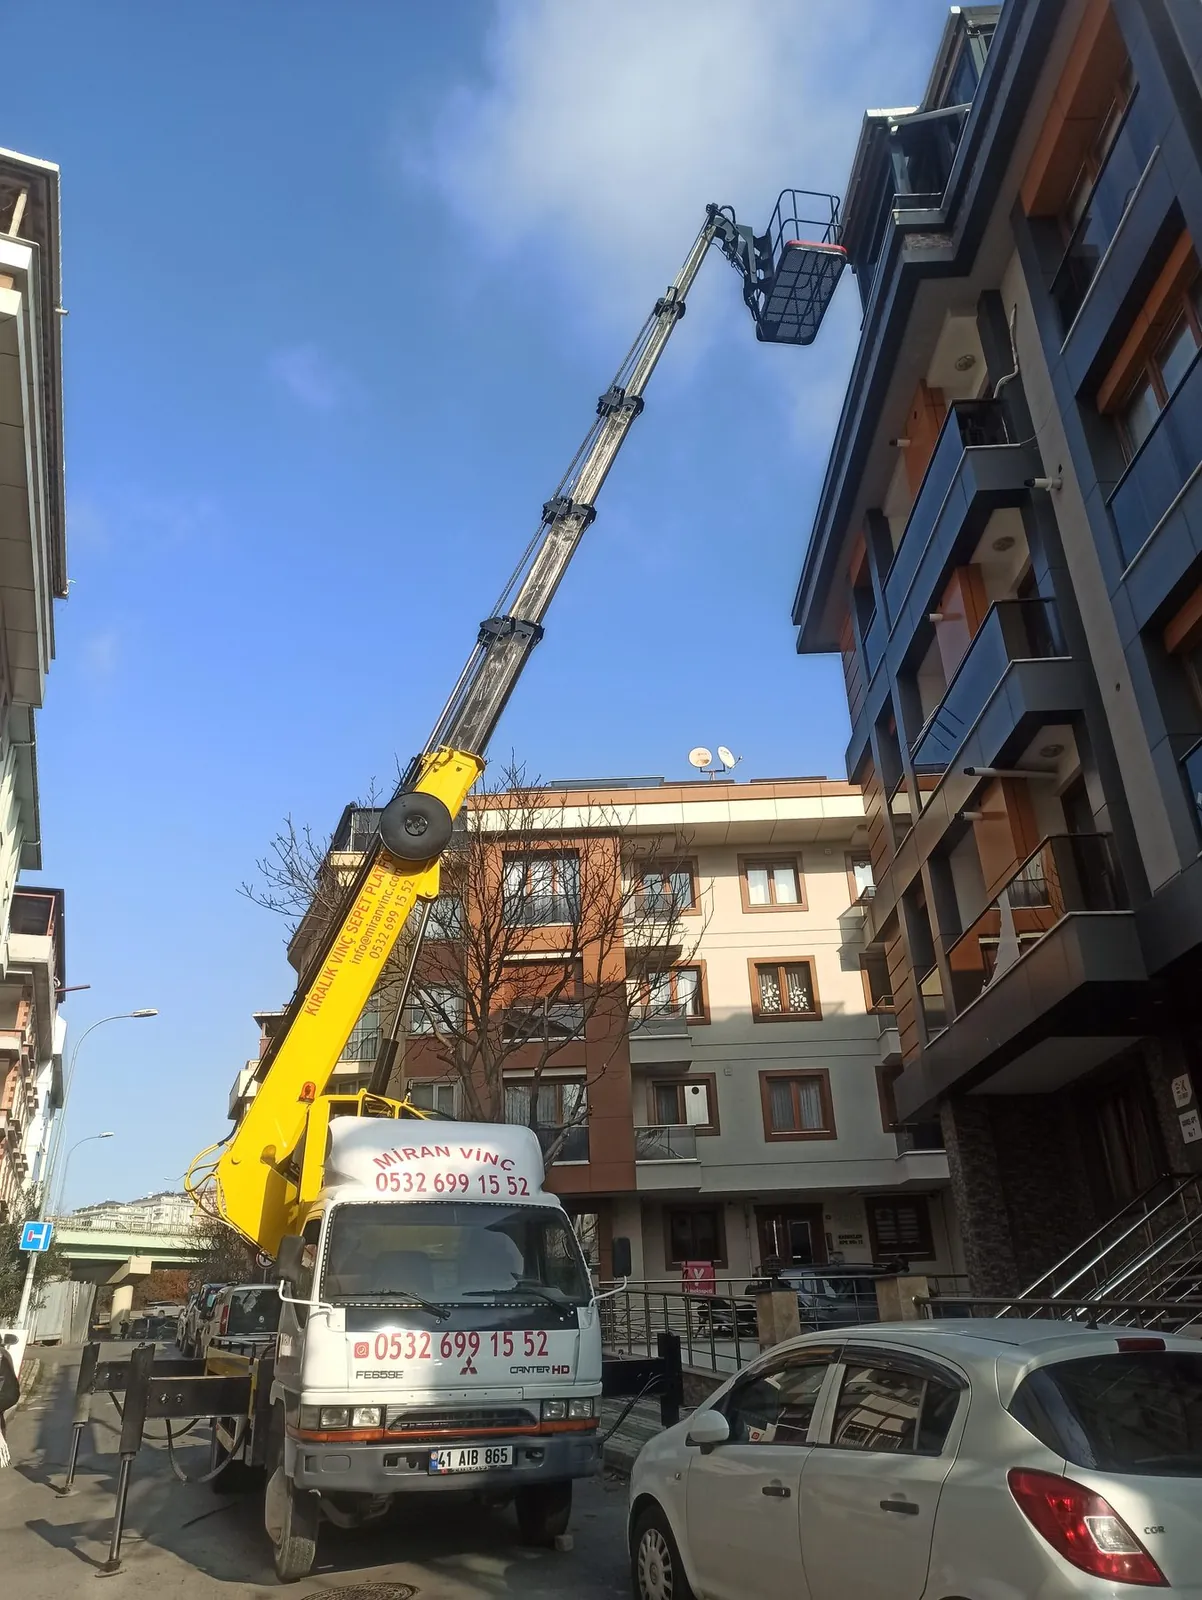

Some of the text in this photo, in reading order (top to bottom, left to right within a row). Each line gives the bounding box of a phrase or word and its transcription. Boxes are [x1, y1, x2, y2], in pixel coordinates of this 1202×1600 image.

[349, 868, 403, 965] info@miranvinc.com
[370, 879, 416, 960] 0532 699 15 52
[305, 967, 339, 1016] KIRALIK
[347, 896, 371, 935] SEPET
[365, 851, 393, 898] PLATFO
[373, 1145, 450, 1170] MİRAN
[375, 1172, 530, 1196] 0532 699 15 52
[374, 1330, 549, 1360] 0532 699 15 52
[509, 1365, 570, 1374] CANTER HD
[438, 1448, 508, 1468] 41 AIB 865
